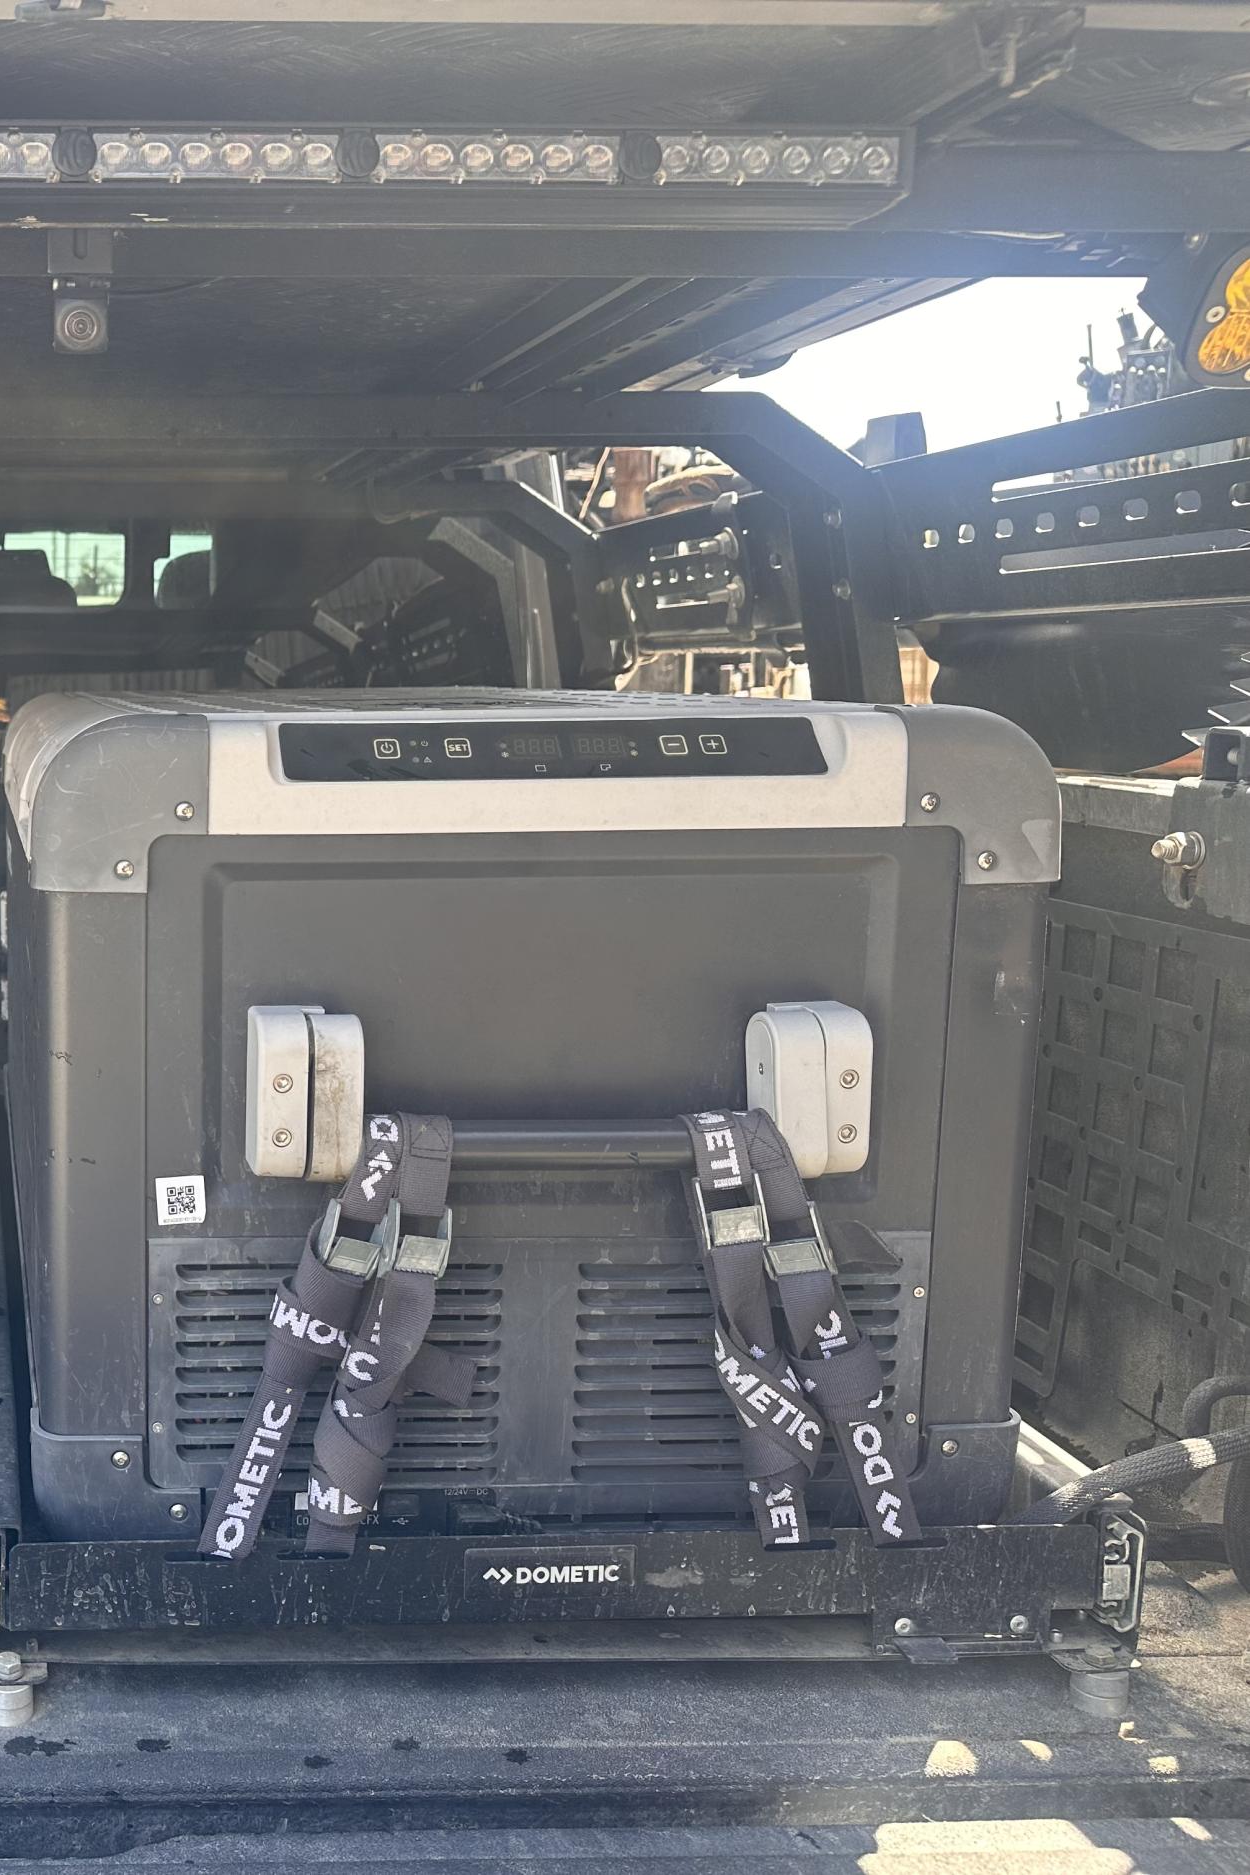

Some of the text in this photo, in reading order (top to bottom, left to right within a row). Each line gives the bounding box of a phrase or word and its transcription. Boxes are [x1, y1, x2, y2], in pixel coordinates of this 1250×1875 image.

[448, 743, 468, 753] SET
[210, 1399, 292, 1560] OMETIC
[516, 1564, 620, 1585] DOMETIC
